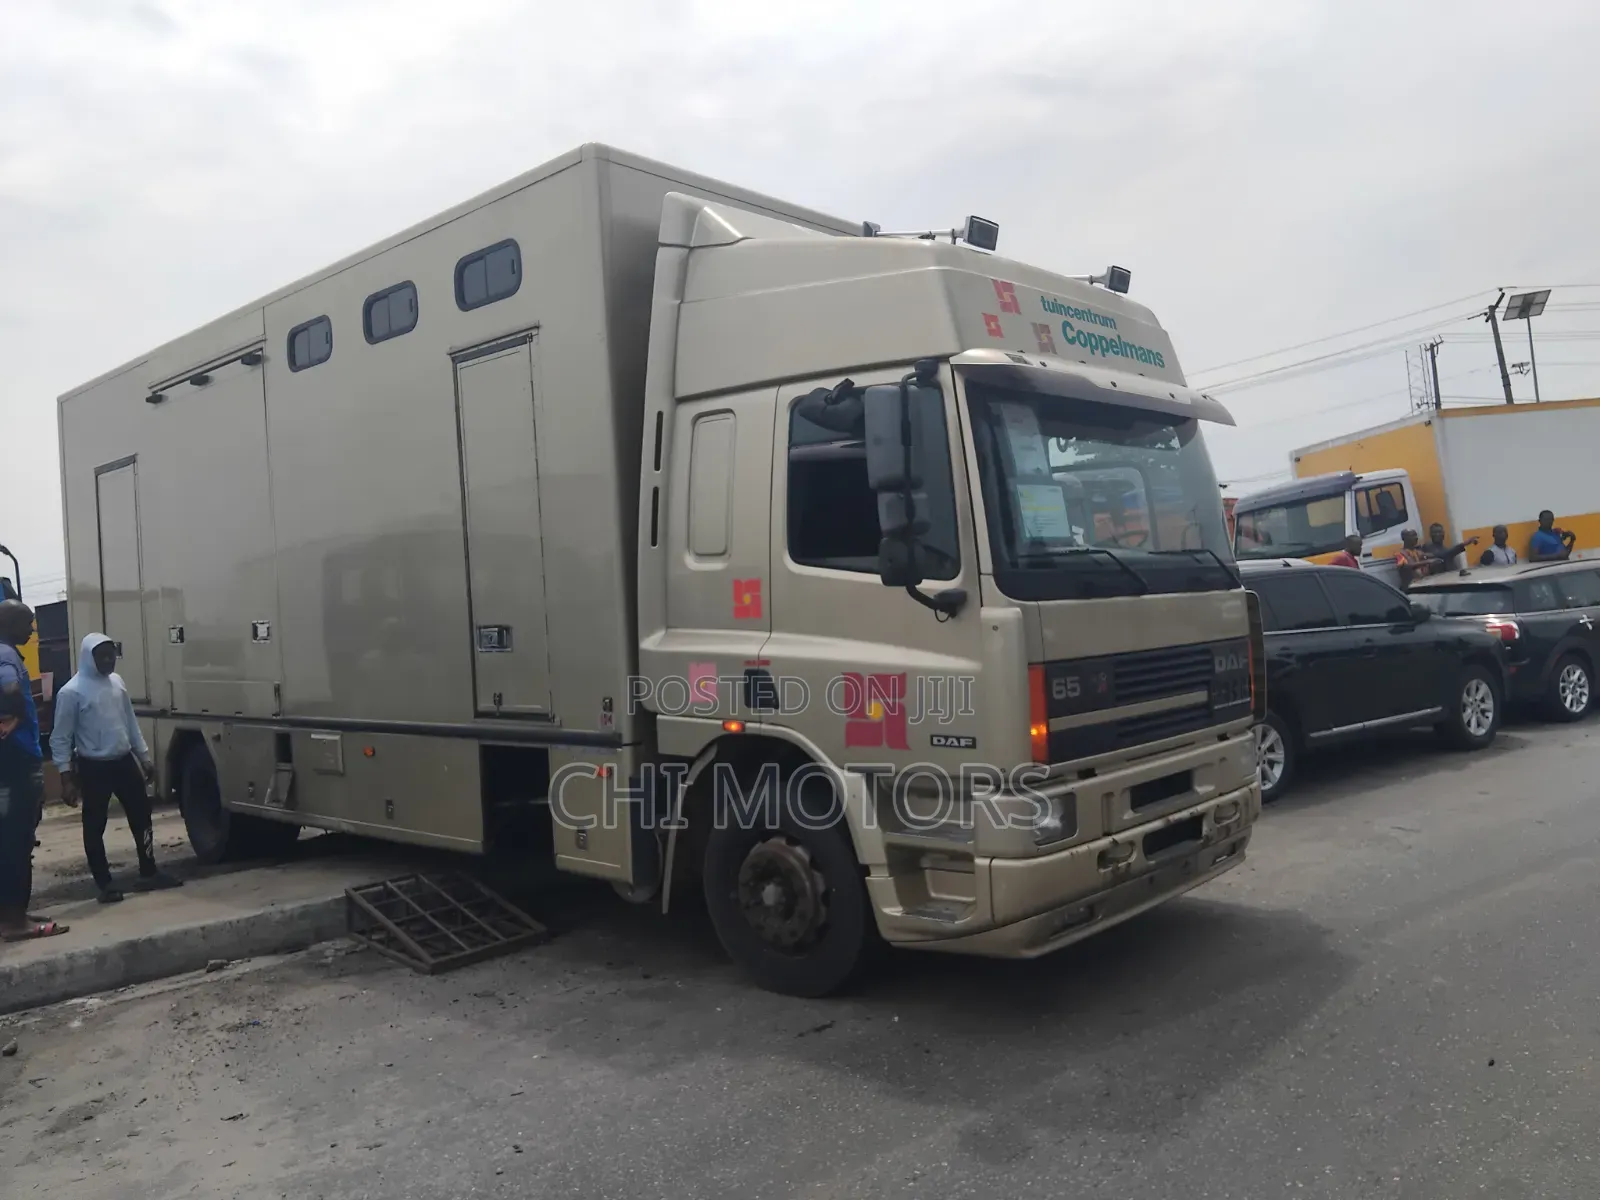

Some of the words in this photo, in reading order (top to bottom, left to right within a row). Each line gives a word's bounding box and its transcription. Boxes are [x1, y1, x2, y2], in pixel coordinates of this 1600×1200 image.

[1041, 295, 1117, 330] tuincentrum
[1062, 321, 1165, 368] Coppelmans
[1052, 676, 1081, 699] 65
[932, 736, 973, 747] DAF
